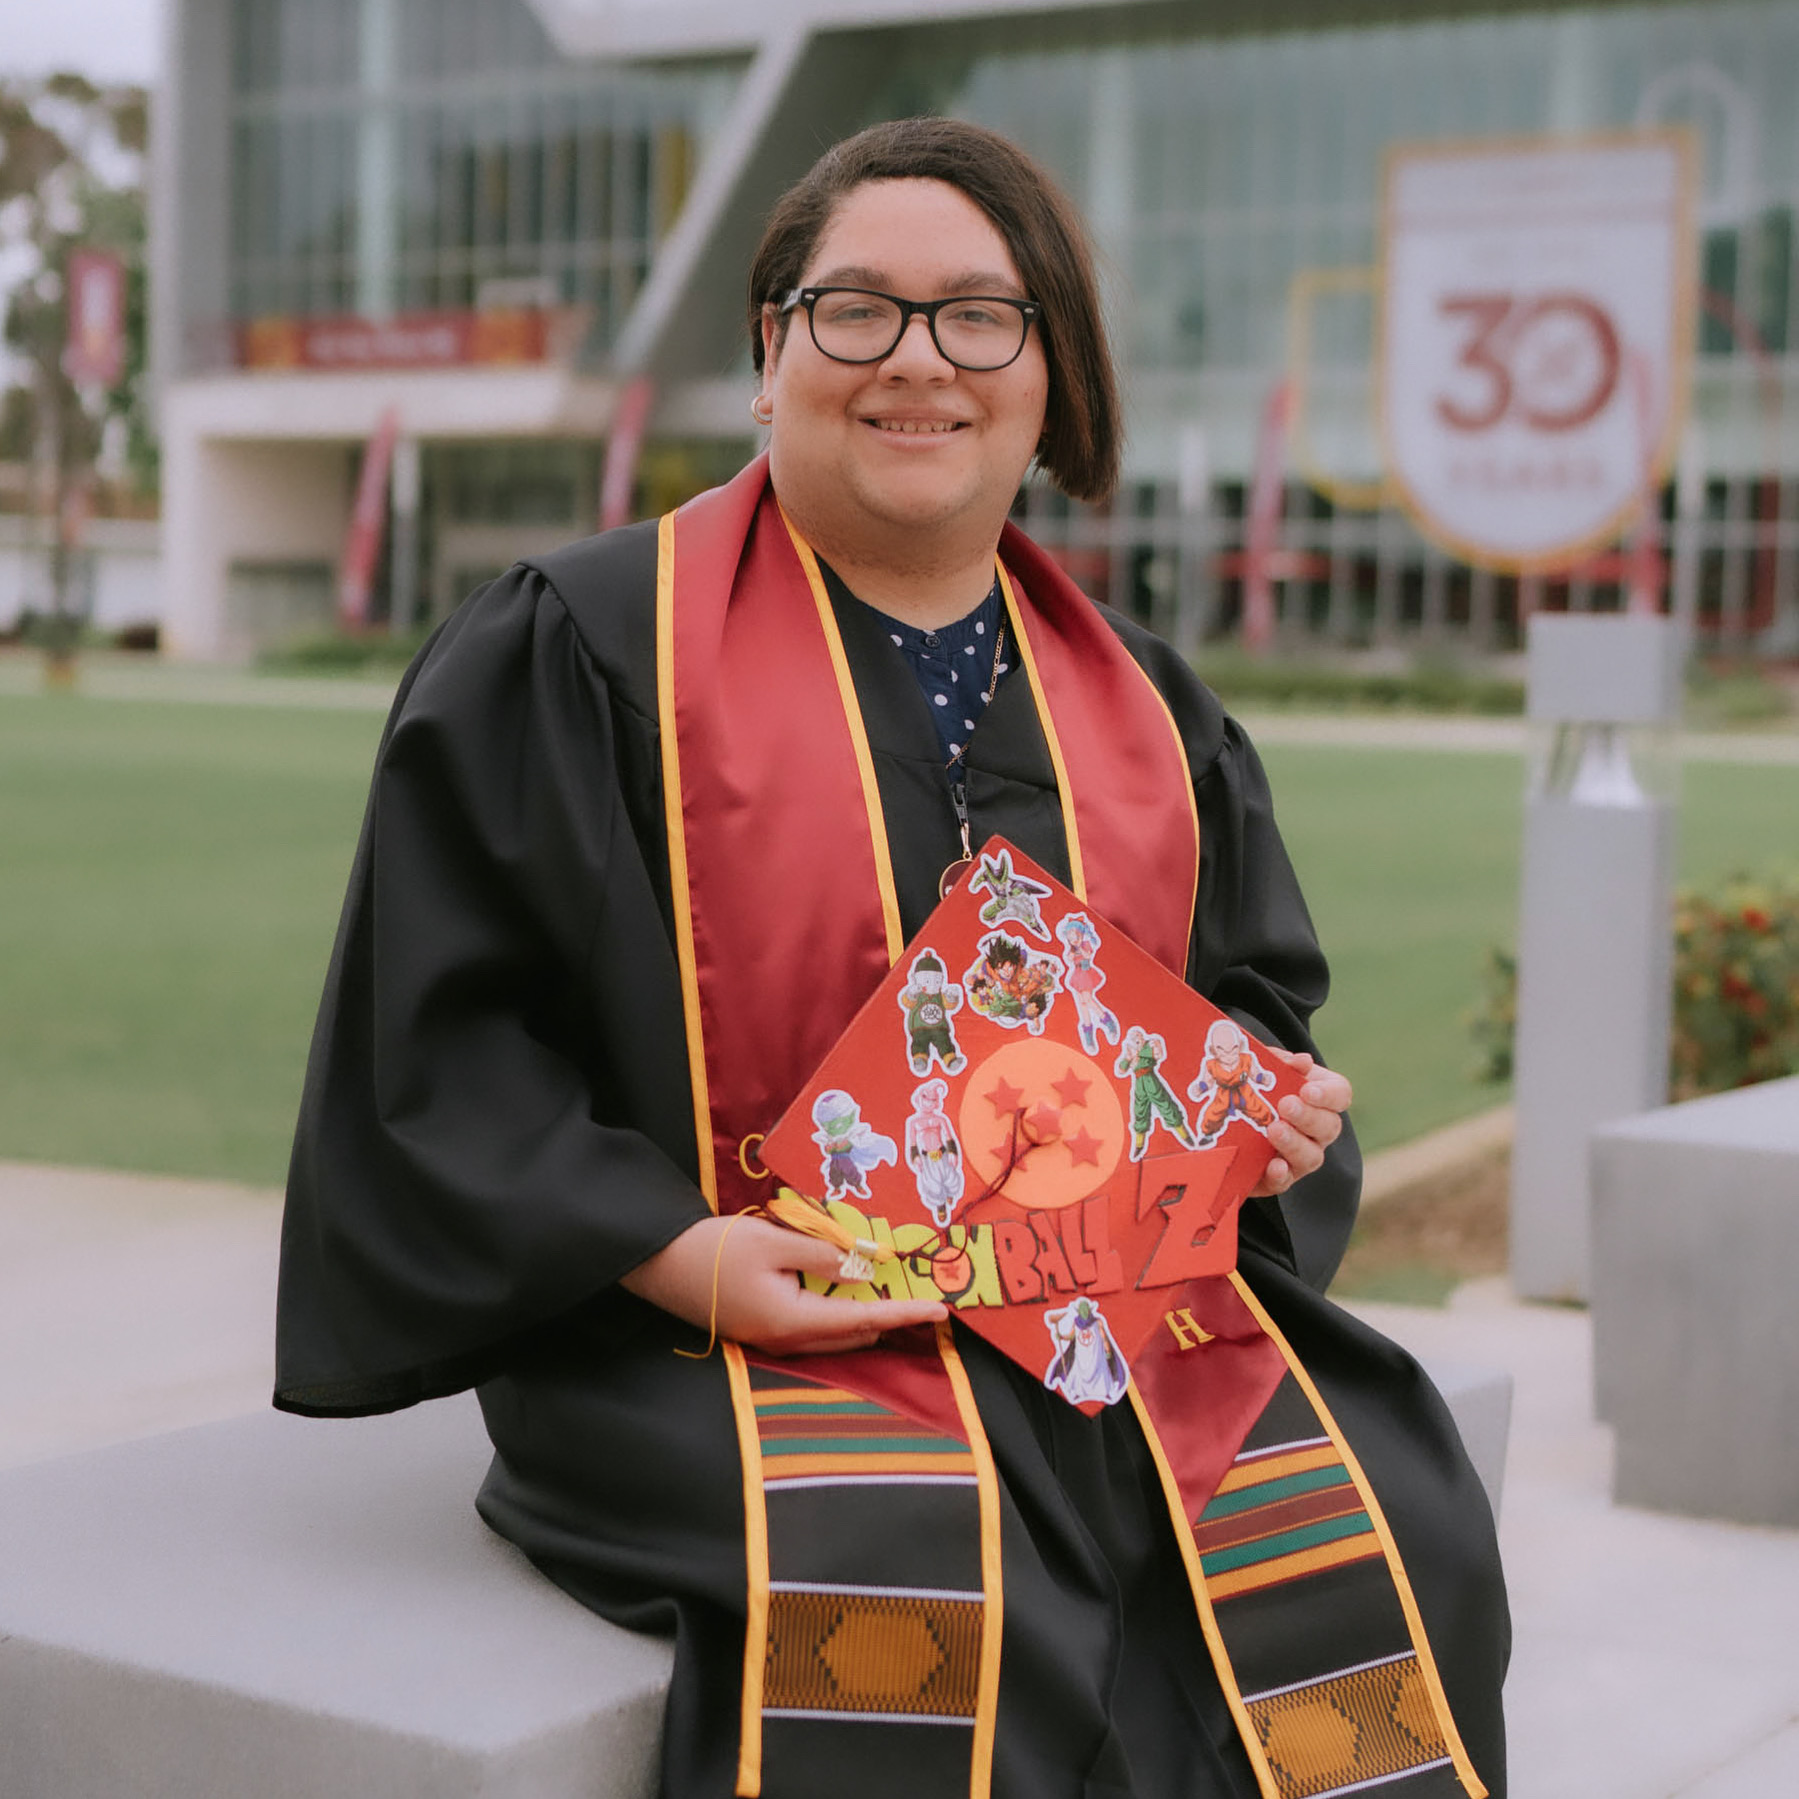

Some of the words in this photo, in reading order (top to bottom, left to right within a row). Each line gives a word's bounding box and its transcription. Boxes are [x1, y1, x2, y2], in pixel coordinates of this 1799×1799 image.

[1434, 289, 1621, 436] 30
[993, 1196, 1124, 1306] BALL
[1134, 1146, 1239, 1290] Z
[1164, 1307, 1216, 1351] H
